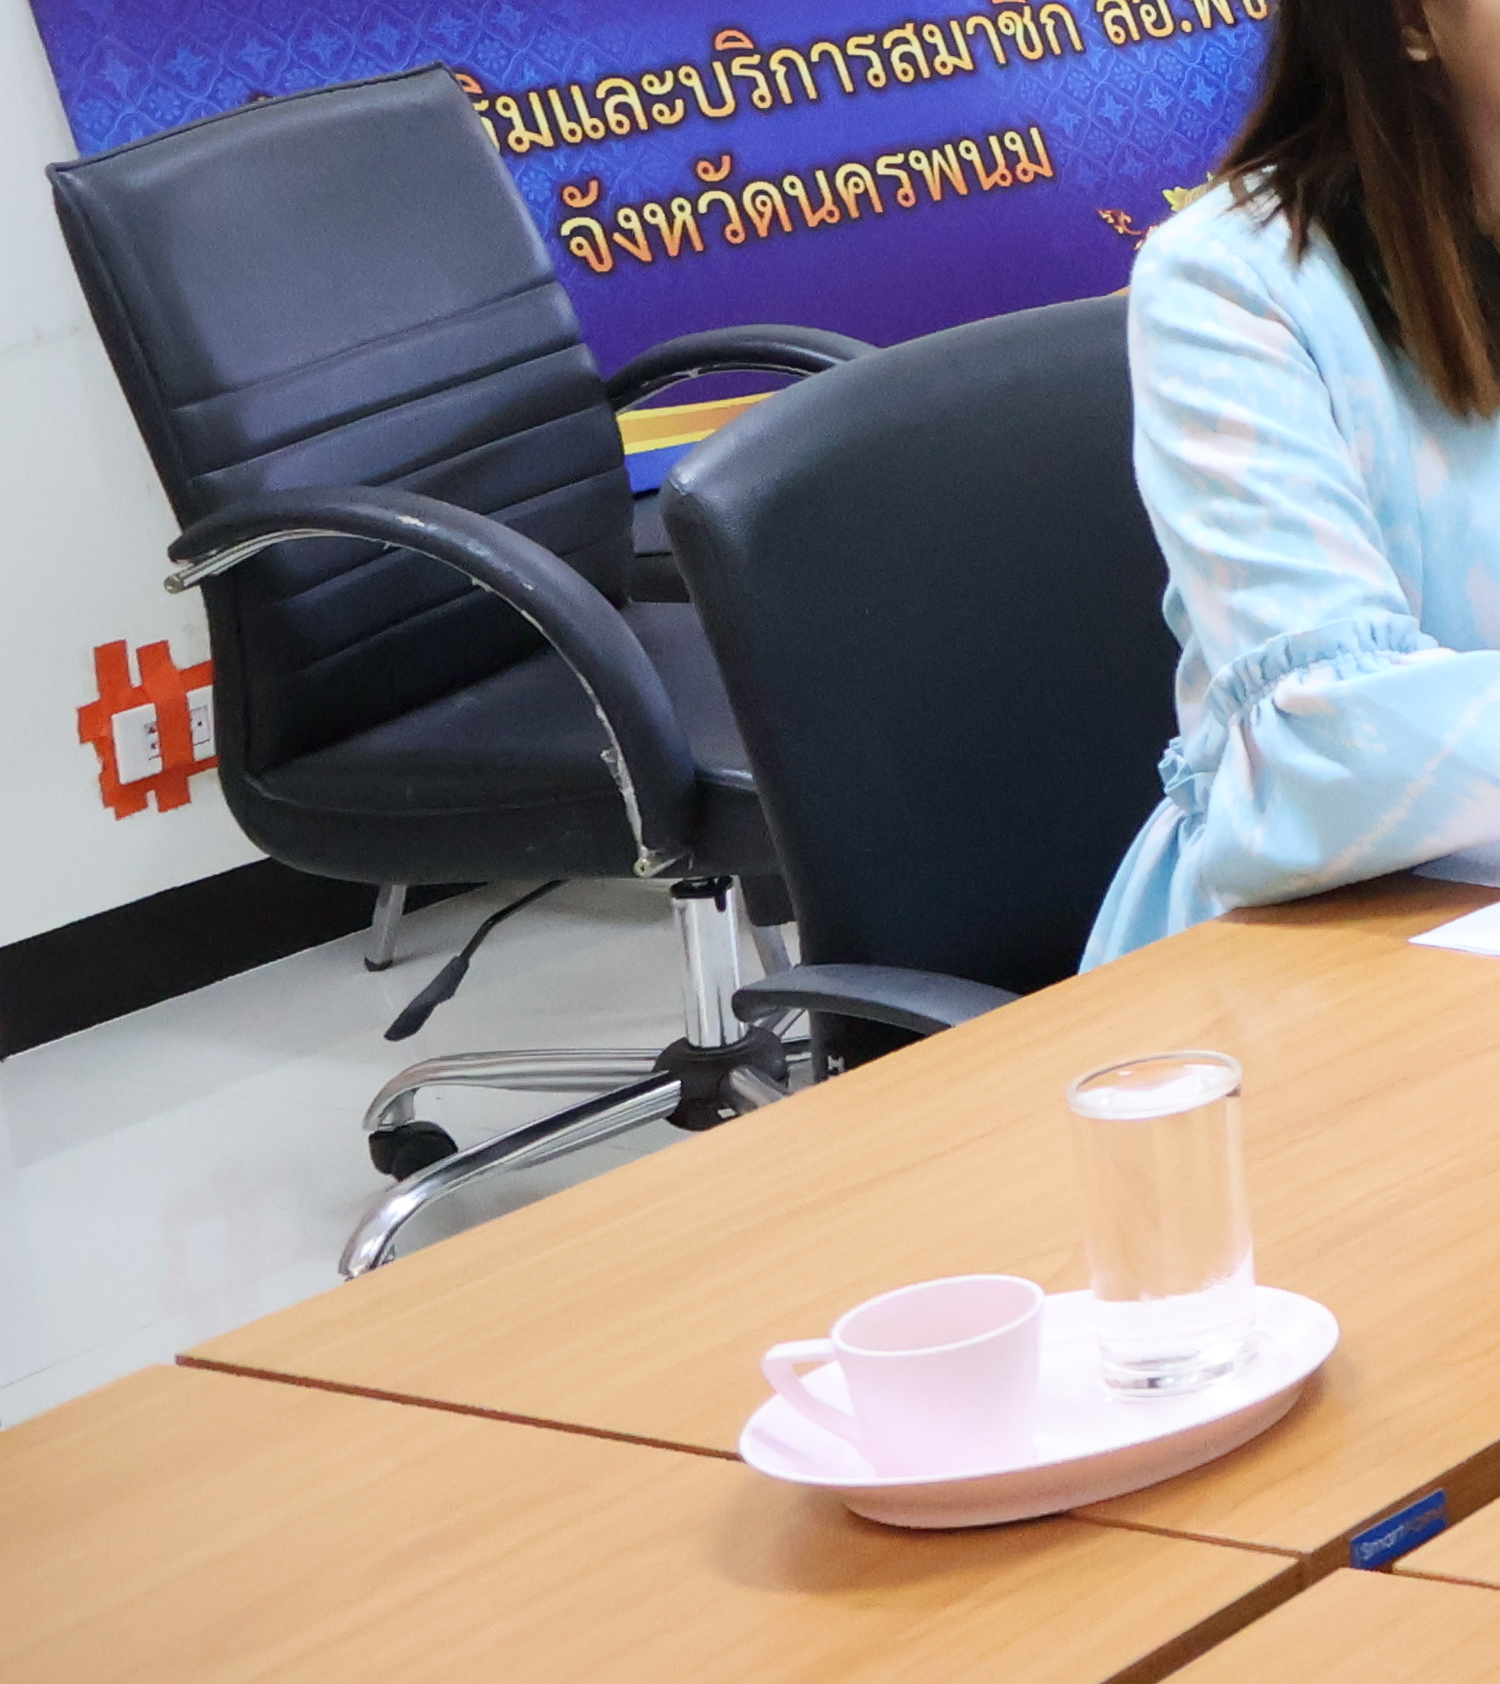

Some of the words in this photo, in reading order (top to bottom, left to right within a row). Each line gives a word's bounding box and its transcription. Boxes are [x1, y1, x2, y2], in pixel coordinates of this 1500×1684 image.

[560, 126, 1054, 274] จังหวัดนครพนม
